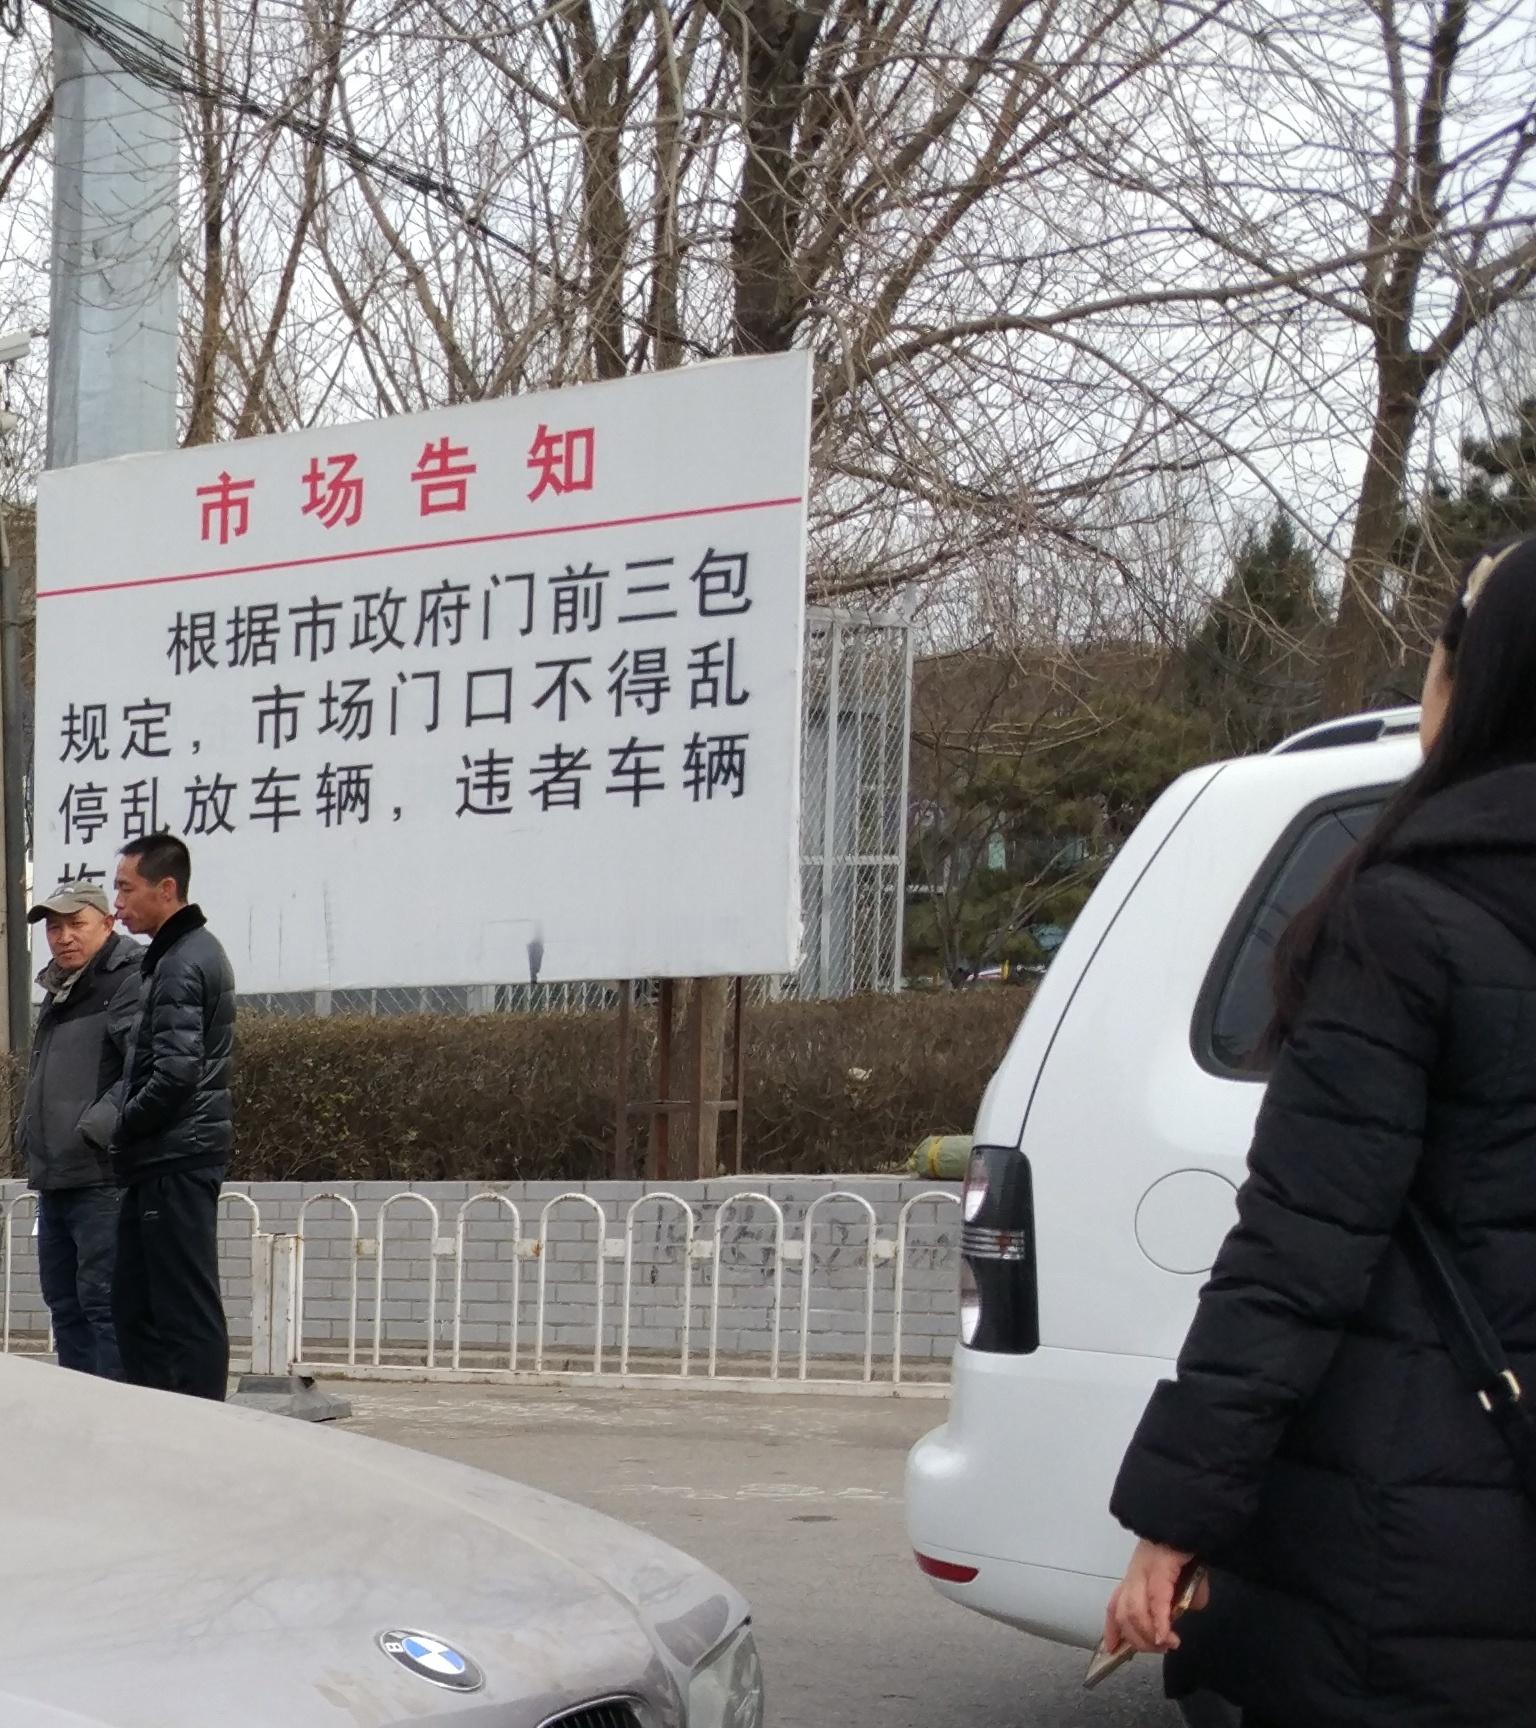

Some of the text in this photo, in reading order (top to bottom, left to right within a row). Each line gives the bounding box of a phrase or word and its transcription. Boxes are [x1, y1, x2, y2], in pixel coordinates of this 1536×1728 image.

[195, 424, 596, 545] 市场告知
[165, 546, 754, 676] 根据市政府门前三包
[58, 640, 751, 763] 规定，市场门口不得乱
[57, 731, 751, 846] 停乱放车辆，违者车辆
